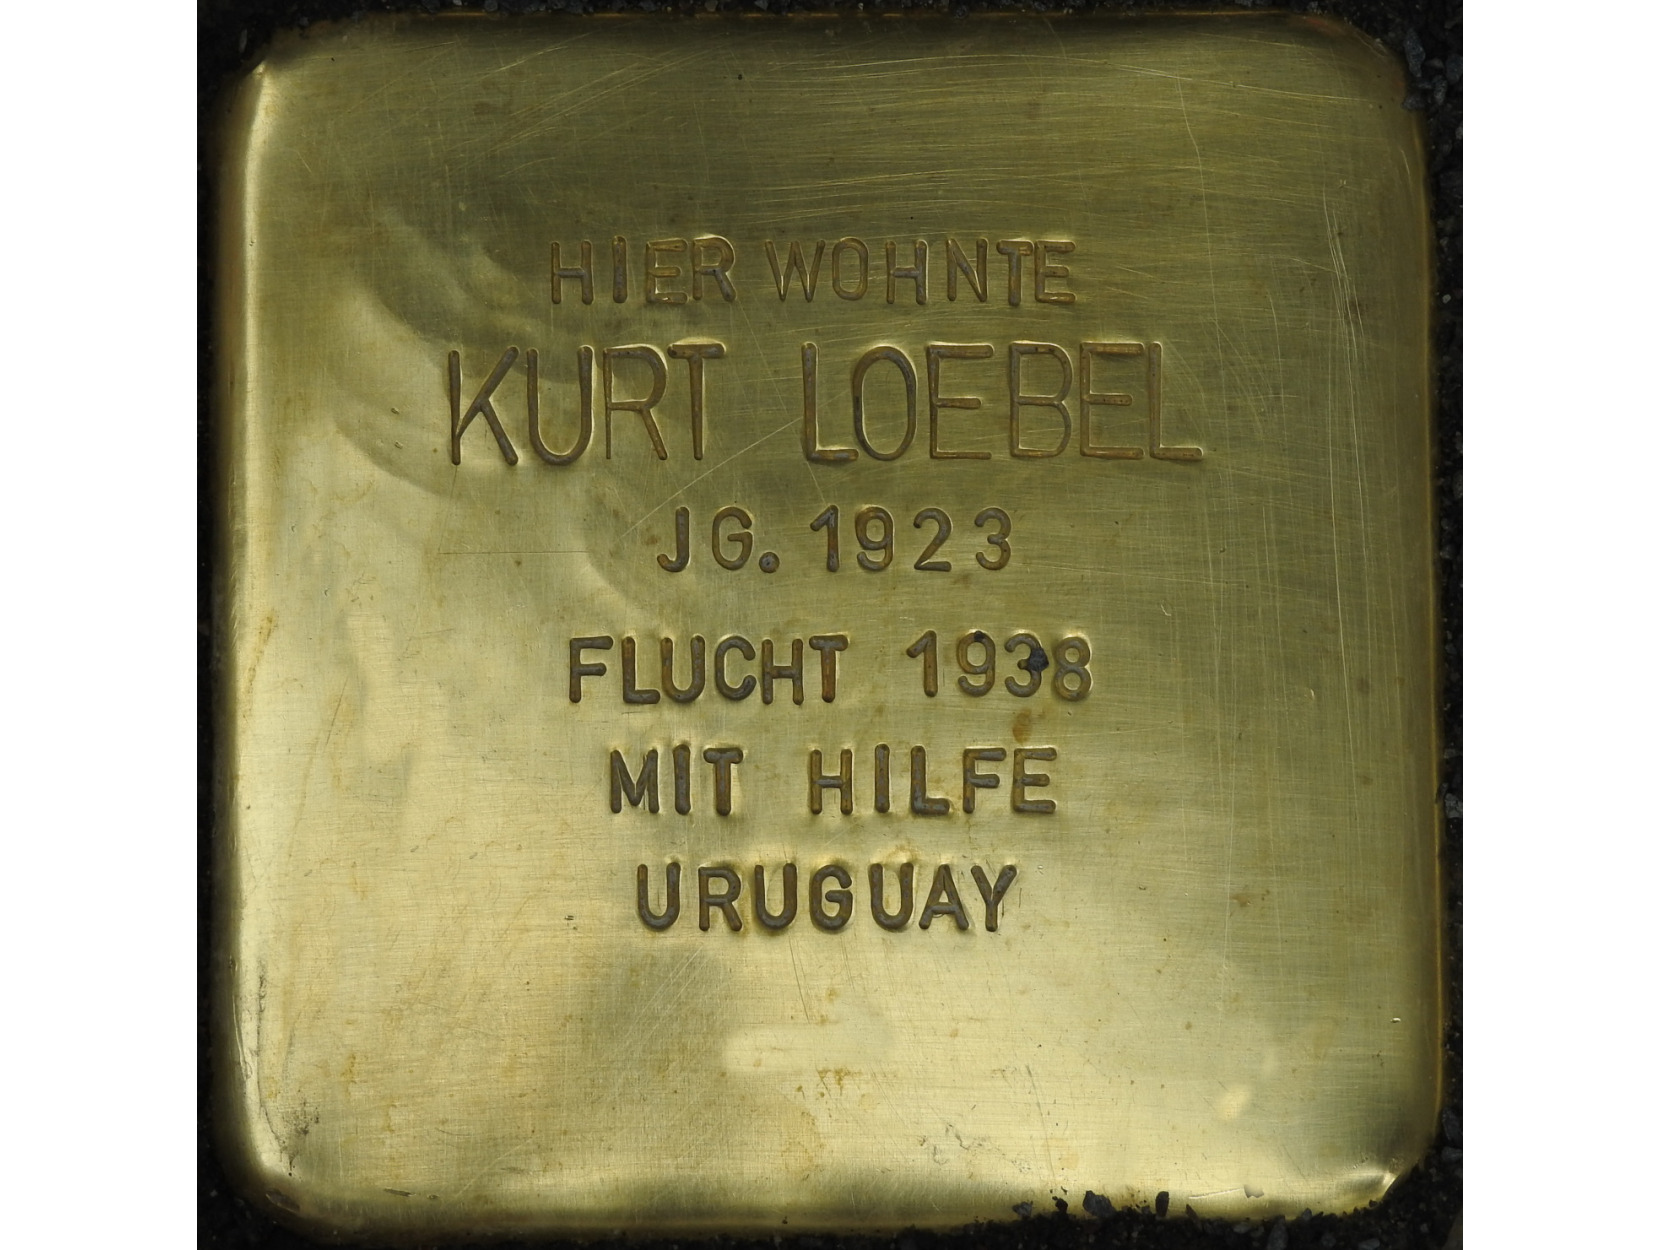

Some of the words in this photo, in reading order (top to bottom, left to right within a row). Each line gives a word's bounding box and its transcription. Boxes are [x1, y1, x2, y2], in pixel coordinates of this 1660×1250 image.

[550, 236, 737, 305] HIER
[764, 237, 1077, 306] WOHNTE
[449, 343, 726, 465] KURT
[801, 341, 1204, 461] LOEBEL
[656, 505, 780, 573] JG.
[810, 504, 1013, 572] 1923
[569, 634, 849, 705] FLUCHT
[906, 630, 1093, 701] 1938
[609, 744, 744, 816] MIT
[809, 743, 1058, 815] HILFE
[637, 861, 1018, 933] URUGUAY
